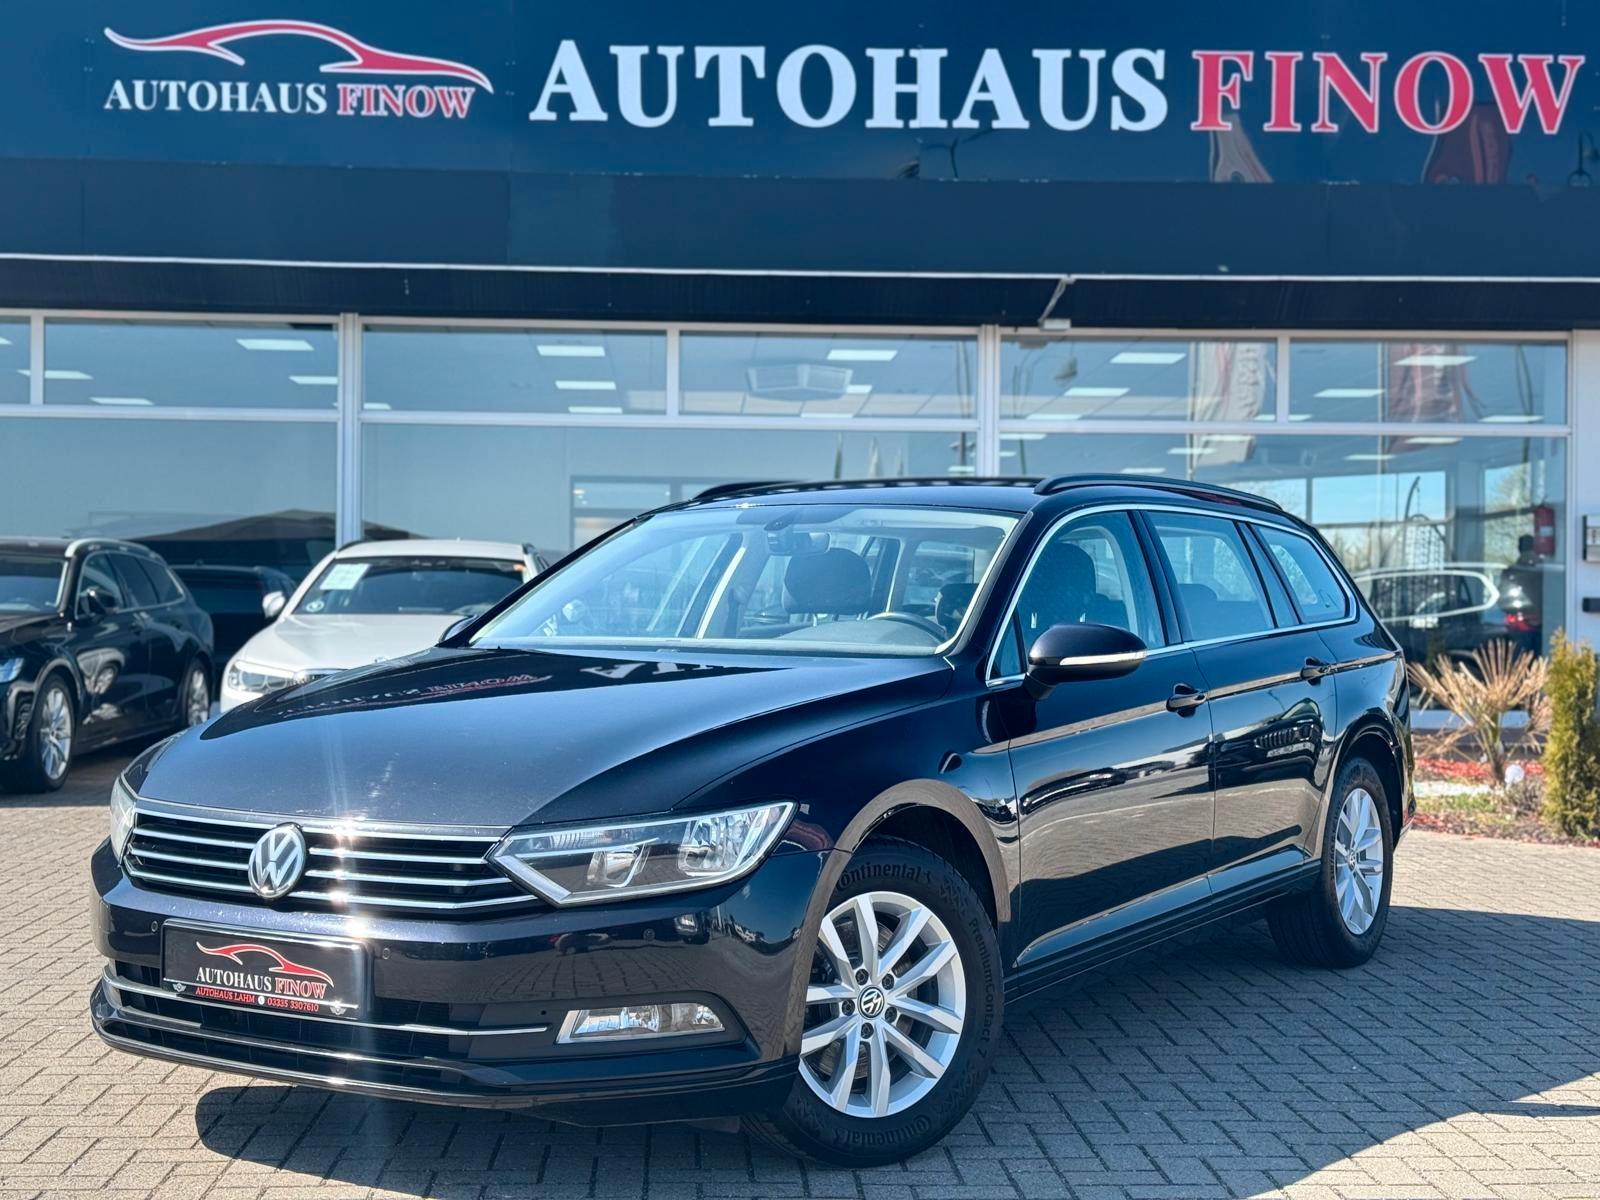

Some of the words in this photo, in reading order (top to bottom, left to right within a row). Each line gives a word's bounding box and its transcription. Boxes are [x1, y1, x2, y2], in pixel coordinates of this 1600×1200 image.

[104, 79, 328, 115] AUTOHAUS
[336, 83, 476, 119] FINOW
[529, 40, 1168, 132] AUTOHAUS
[1190, 51, 1586, 135] FINOW
[836, 861, 922, 891] Continental
[195, 986, 233, 1000] AUTOHAUS
[234, 993, 255, 1004] LAHM
[197, 966, 272, 992] AUTOHAUS
[275, 977, 327, 999] FINOW
[968, 917, 995, 1042] PremiumContact
